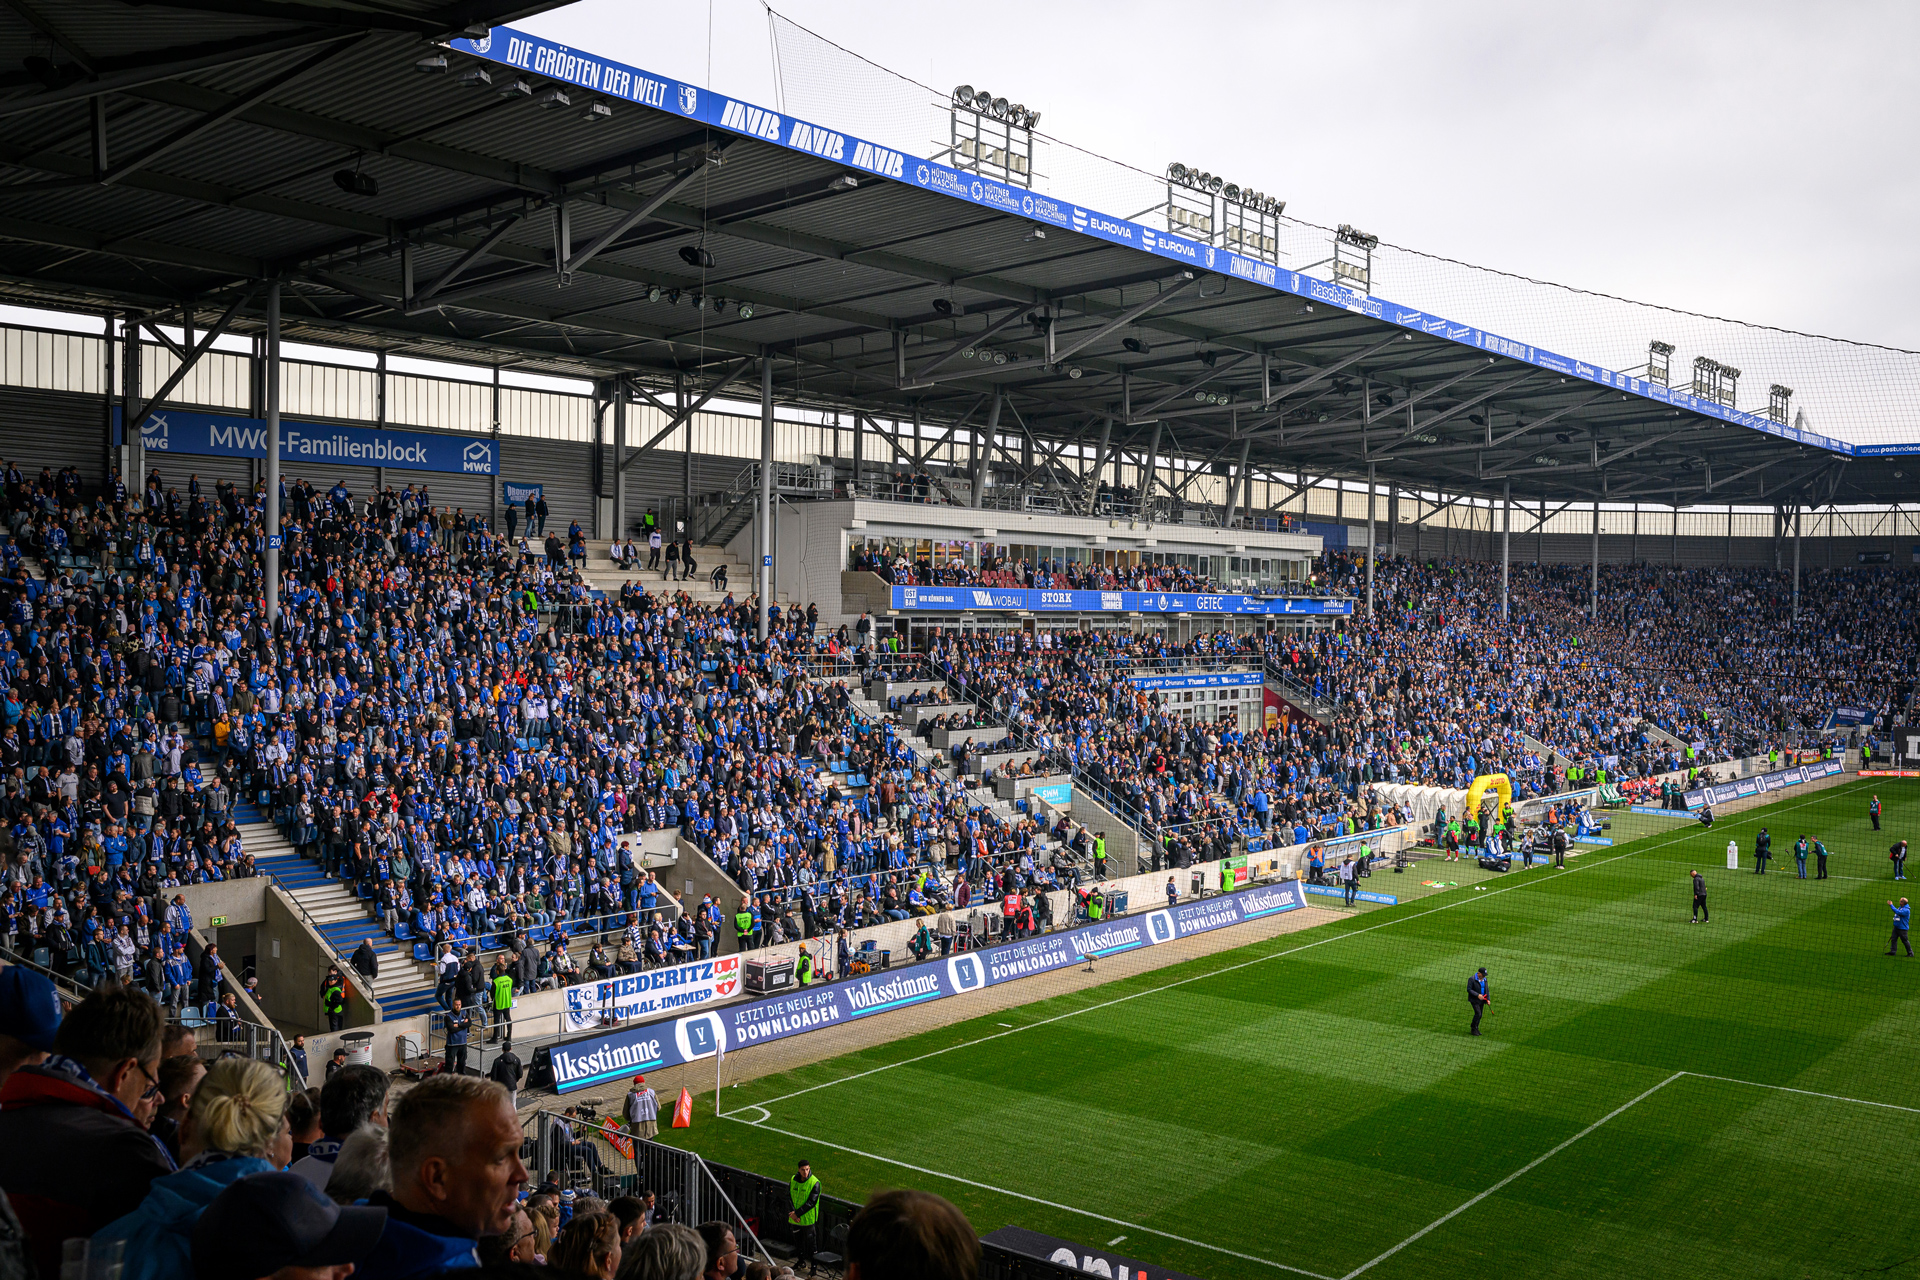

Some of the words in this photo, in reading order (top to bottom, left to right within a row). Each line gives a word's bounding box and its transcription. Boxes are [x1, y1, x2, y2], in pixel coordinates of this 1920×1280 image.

[506, 37, 533, 68] DIE
[602, 66, 631, 97] DER
[632, 75, 668, 107] WELT
[931, 167, 958, 182] HÜTTNER
[931, 176, 968, 193] MASCHINEN
[984, 183, 1010, 197] HÜTTNER
[984, 192, 1019, 207] MASCHINEN
[1035, 198, 1058, 211] HÜTTNER
[1035, 206, 1067, 222] MASCHINEN
[1090, 218, 1132, 240] EUROVIA
[1158, 237, 1196, 258] EUROVIA
[1230, 256, 1276, 286] EINMAL-IMMER
[1311, 279, 1382, 319] Rasch-Reinigung
[463, 461, 491, 473] MWG
[270, 537, 281, 546] 20
[905, 589, 915, 597] OST
[993, 595, 1022, 606] WOBAU
[1041, 592, 1072, 602] STORK
[1101, 592, 1122, 601] EINMAL
[1196, 596, 1223, 610] GETEC
[1042, 788, 1058, 798] SWM
[1178, 909, 1195, 920] JETZT
[1196, 907, 1206, 915] DIE
[1206, 903, 1222, 913] NEUE
[1222, 899, 1234, 910] APP
[1239, 891, 1294, 914] Volksstimme
[1180, 910, 1238, 933] DOWNLOADEN
[1070, 925, 1141, 955] Volksstimme
[990, 952, 1012, 965] JETZT
[1013, 948, 1026, 959] DIE
[1027, 944, 1048, 956] NEUE
[1049, 938, 1063, 951] APP
[992, 950, 1067, 980] DOWNLOADEN
[597, 962, 714, 1001] BIEDERITZ
[845, 973, 939, 1010] Volksstimme
[735, 1009, 764, 1025] JETZT
[767, 1003, 785, 1017] DIE
[787, 997, 815, 1013] NEUE
[816, 991, 834, 1008] APP
[737, 1004, 839, 1042] DOWNLOADEN
